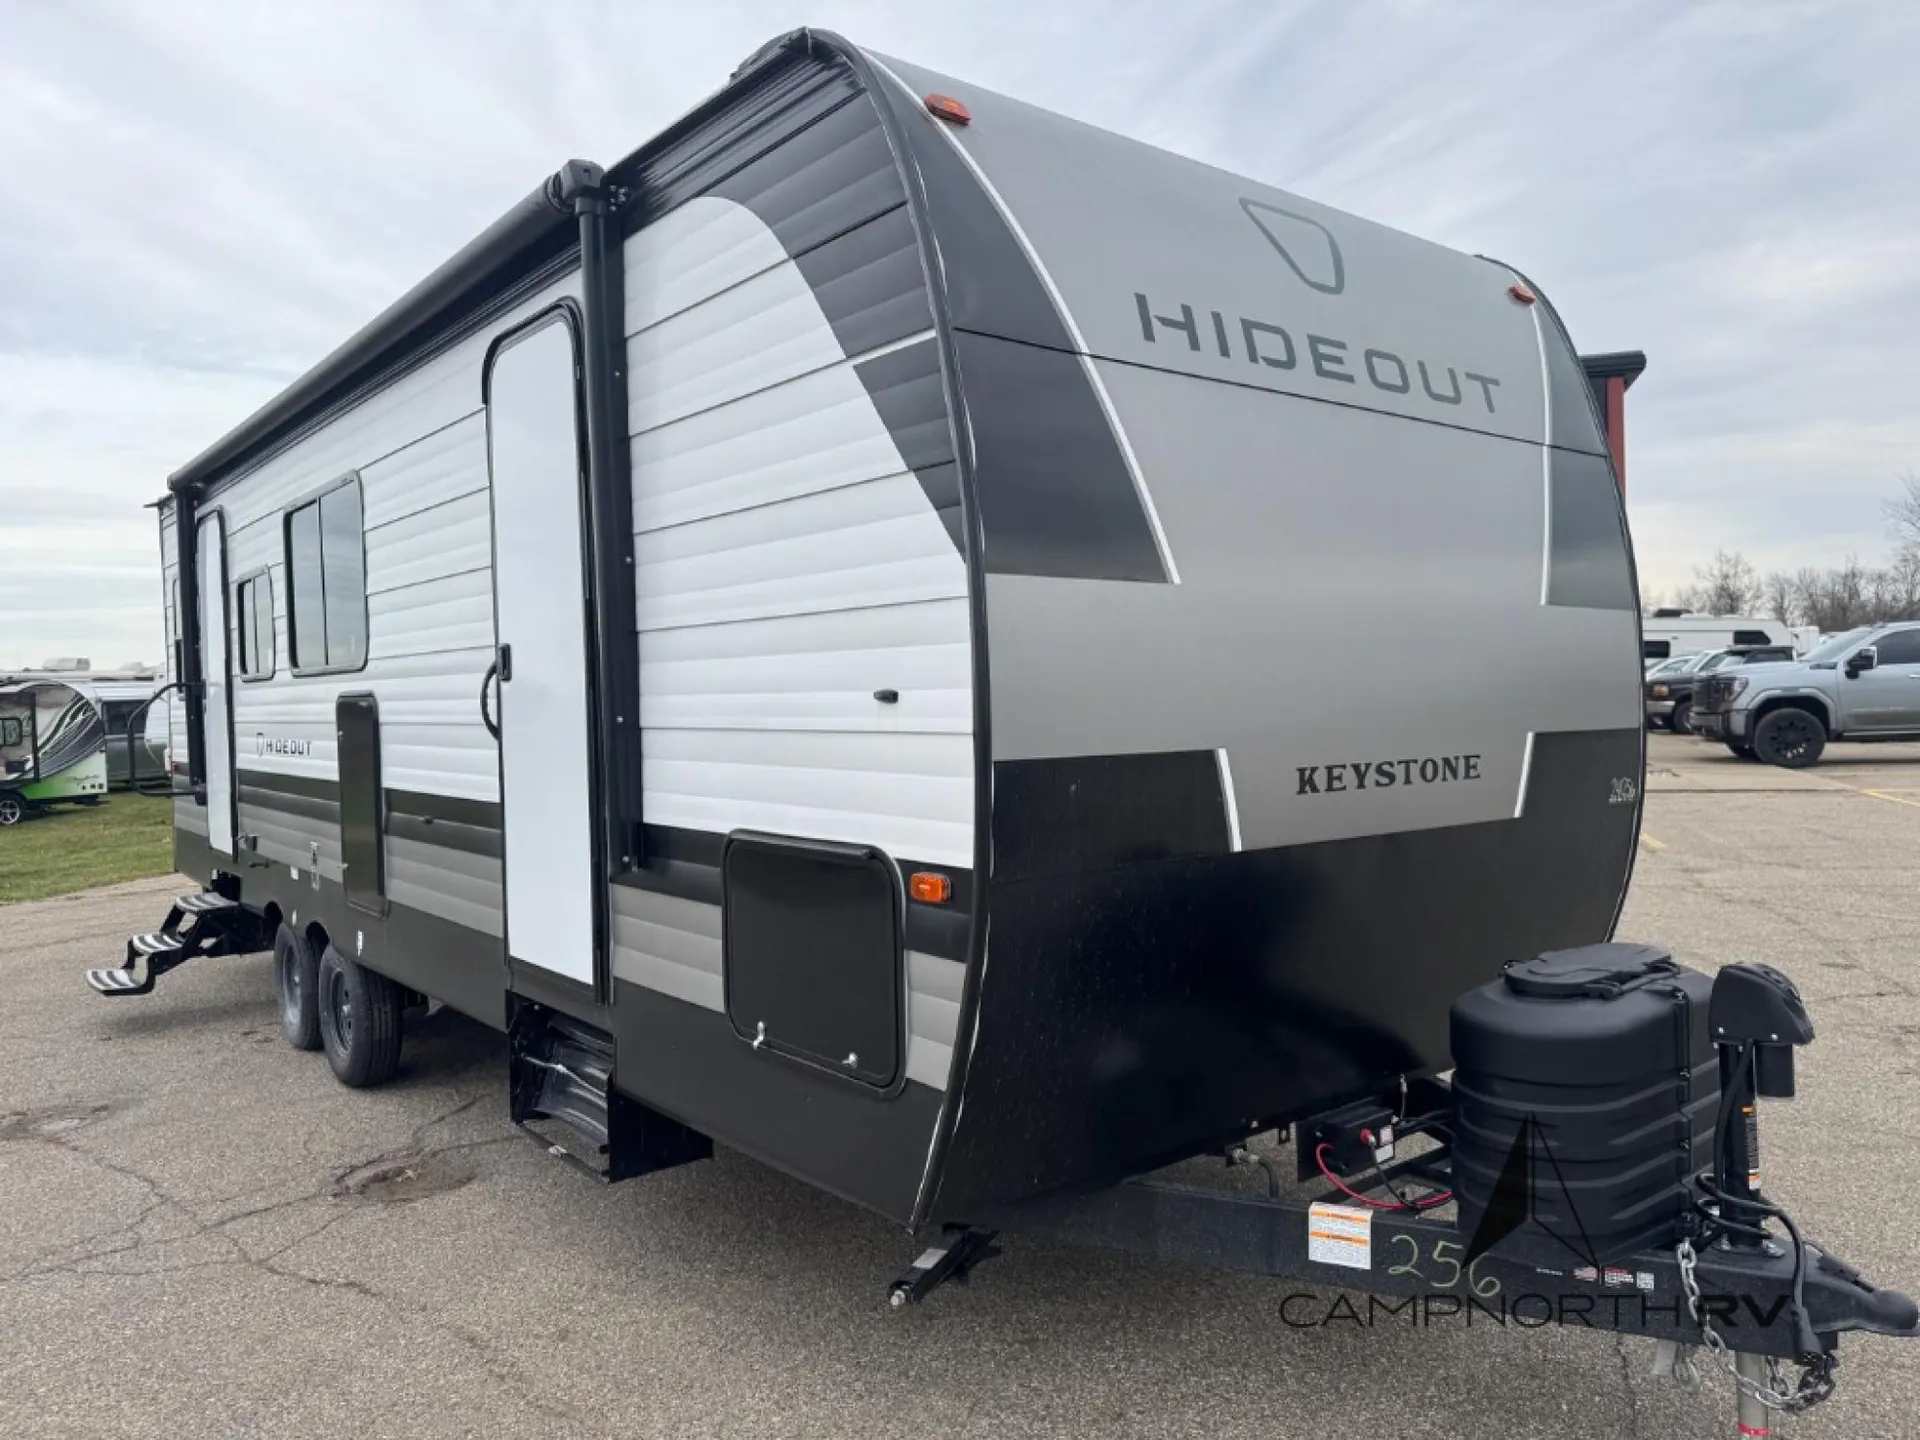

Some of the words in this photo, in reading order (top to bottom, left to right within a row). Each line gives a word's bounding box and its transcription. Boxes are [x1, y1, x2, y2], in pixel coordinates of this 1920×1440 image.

[1134, 292, 1500, 414] HIDEOUT
[1296, 754, 1481, 796] KEYSTONE
[1387, 1235, 1501, 1298] 256
